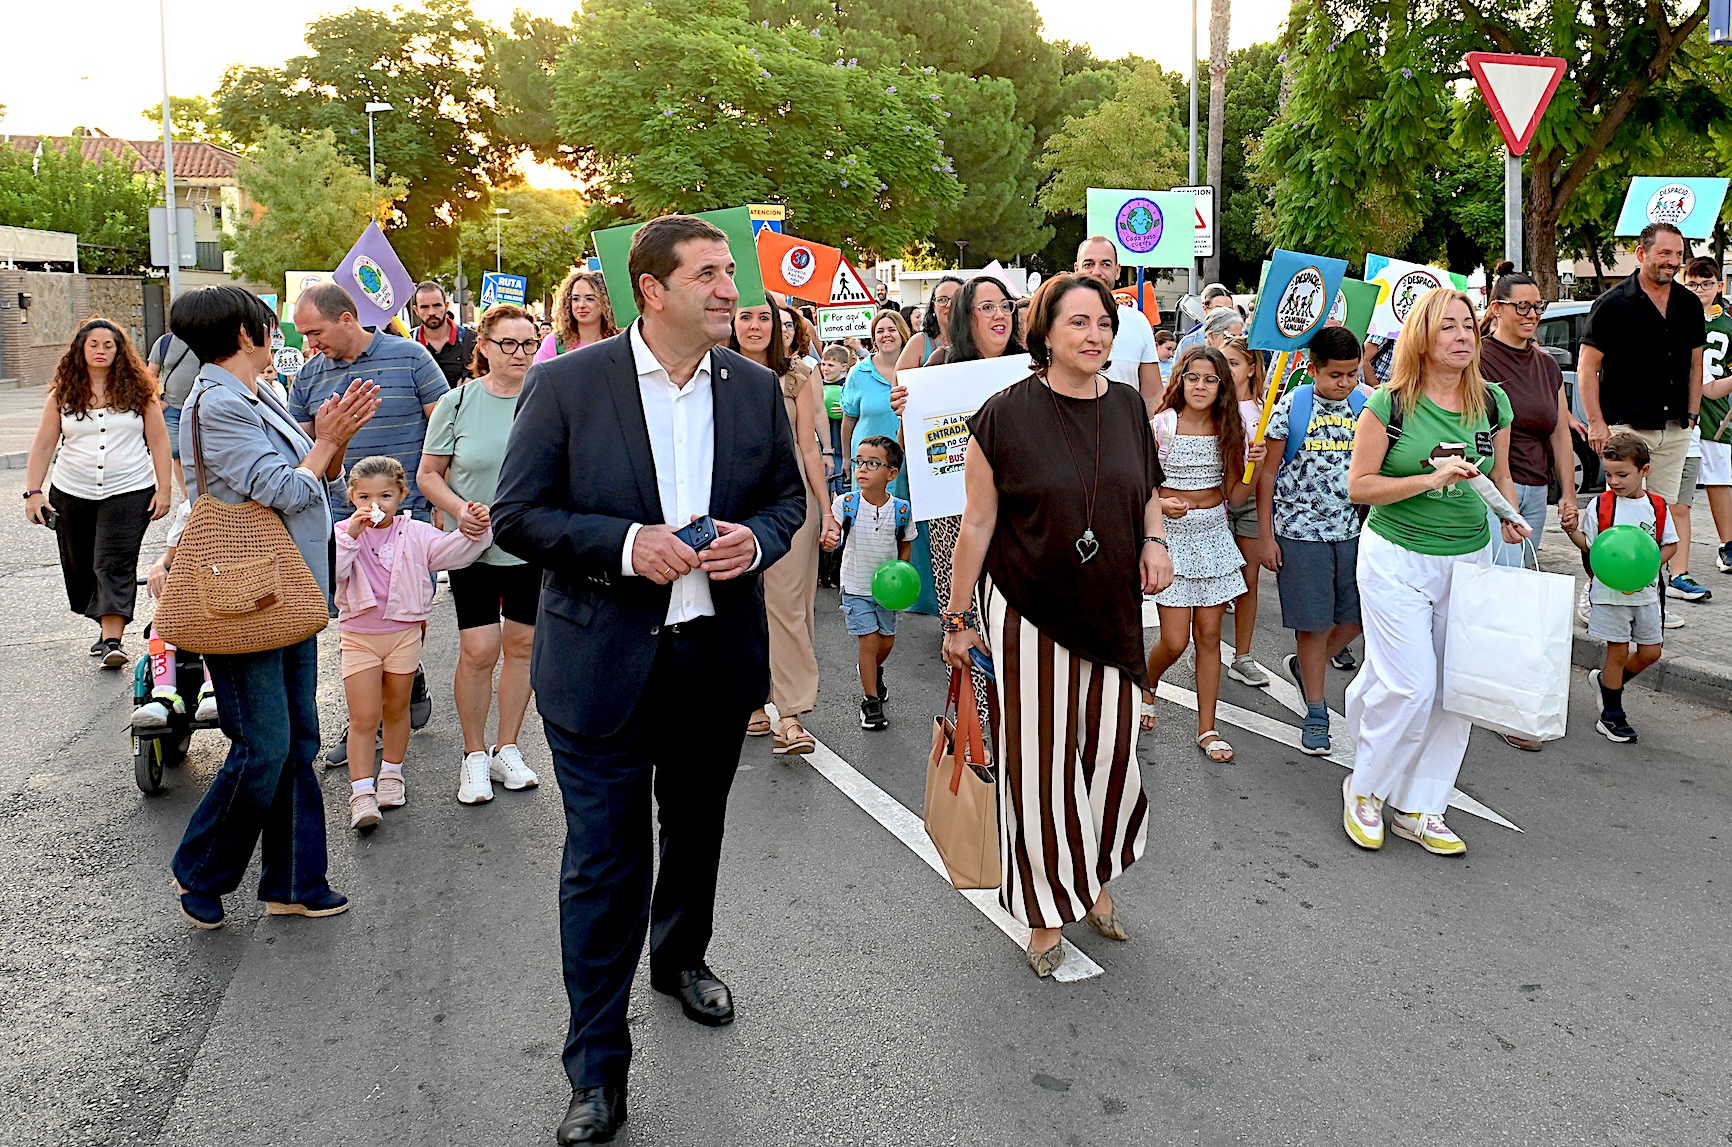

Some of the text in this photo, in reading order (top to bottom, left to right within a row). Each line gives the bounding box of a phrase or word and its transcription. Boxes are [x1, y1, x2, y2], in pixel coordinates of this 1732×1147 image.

[1660, 187, 1689, 196] DESPACIO
[793, 251, 808, 266] 30
[498, 276, 522, 288] RUTA
[832, 312, 860, 323] Por aquí
[845, 322, 852, 331] al
[854, 321, 867, 331] cole
[943, 418, 949, 426] A
[950, 416, 958, 424] la
[927, 424, 967, 442] ENTRADA
[947, 439, 957, 447] no
[949, 453, 965, 464] BUS
